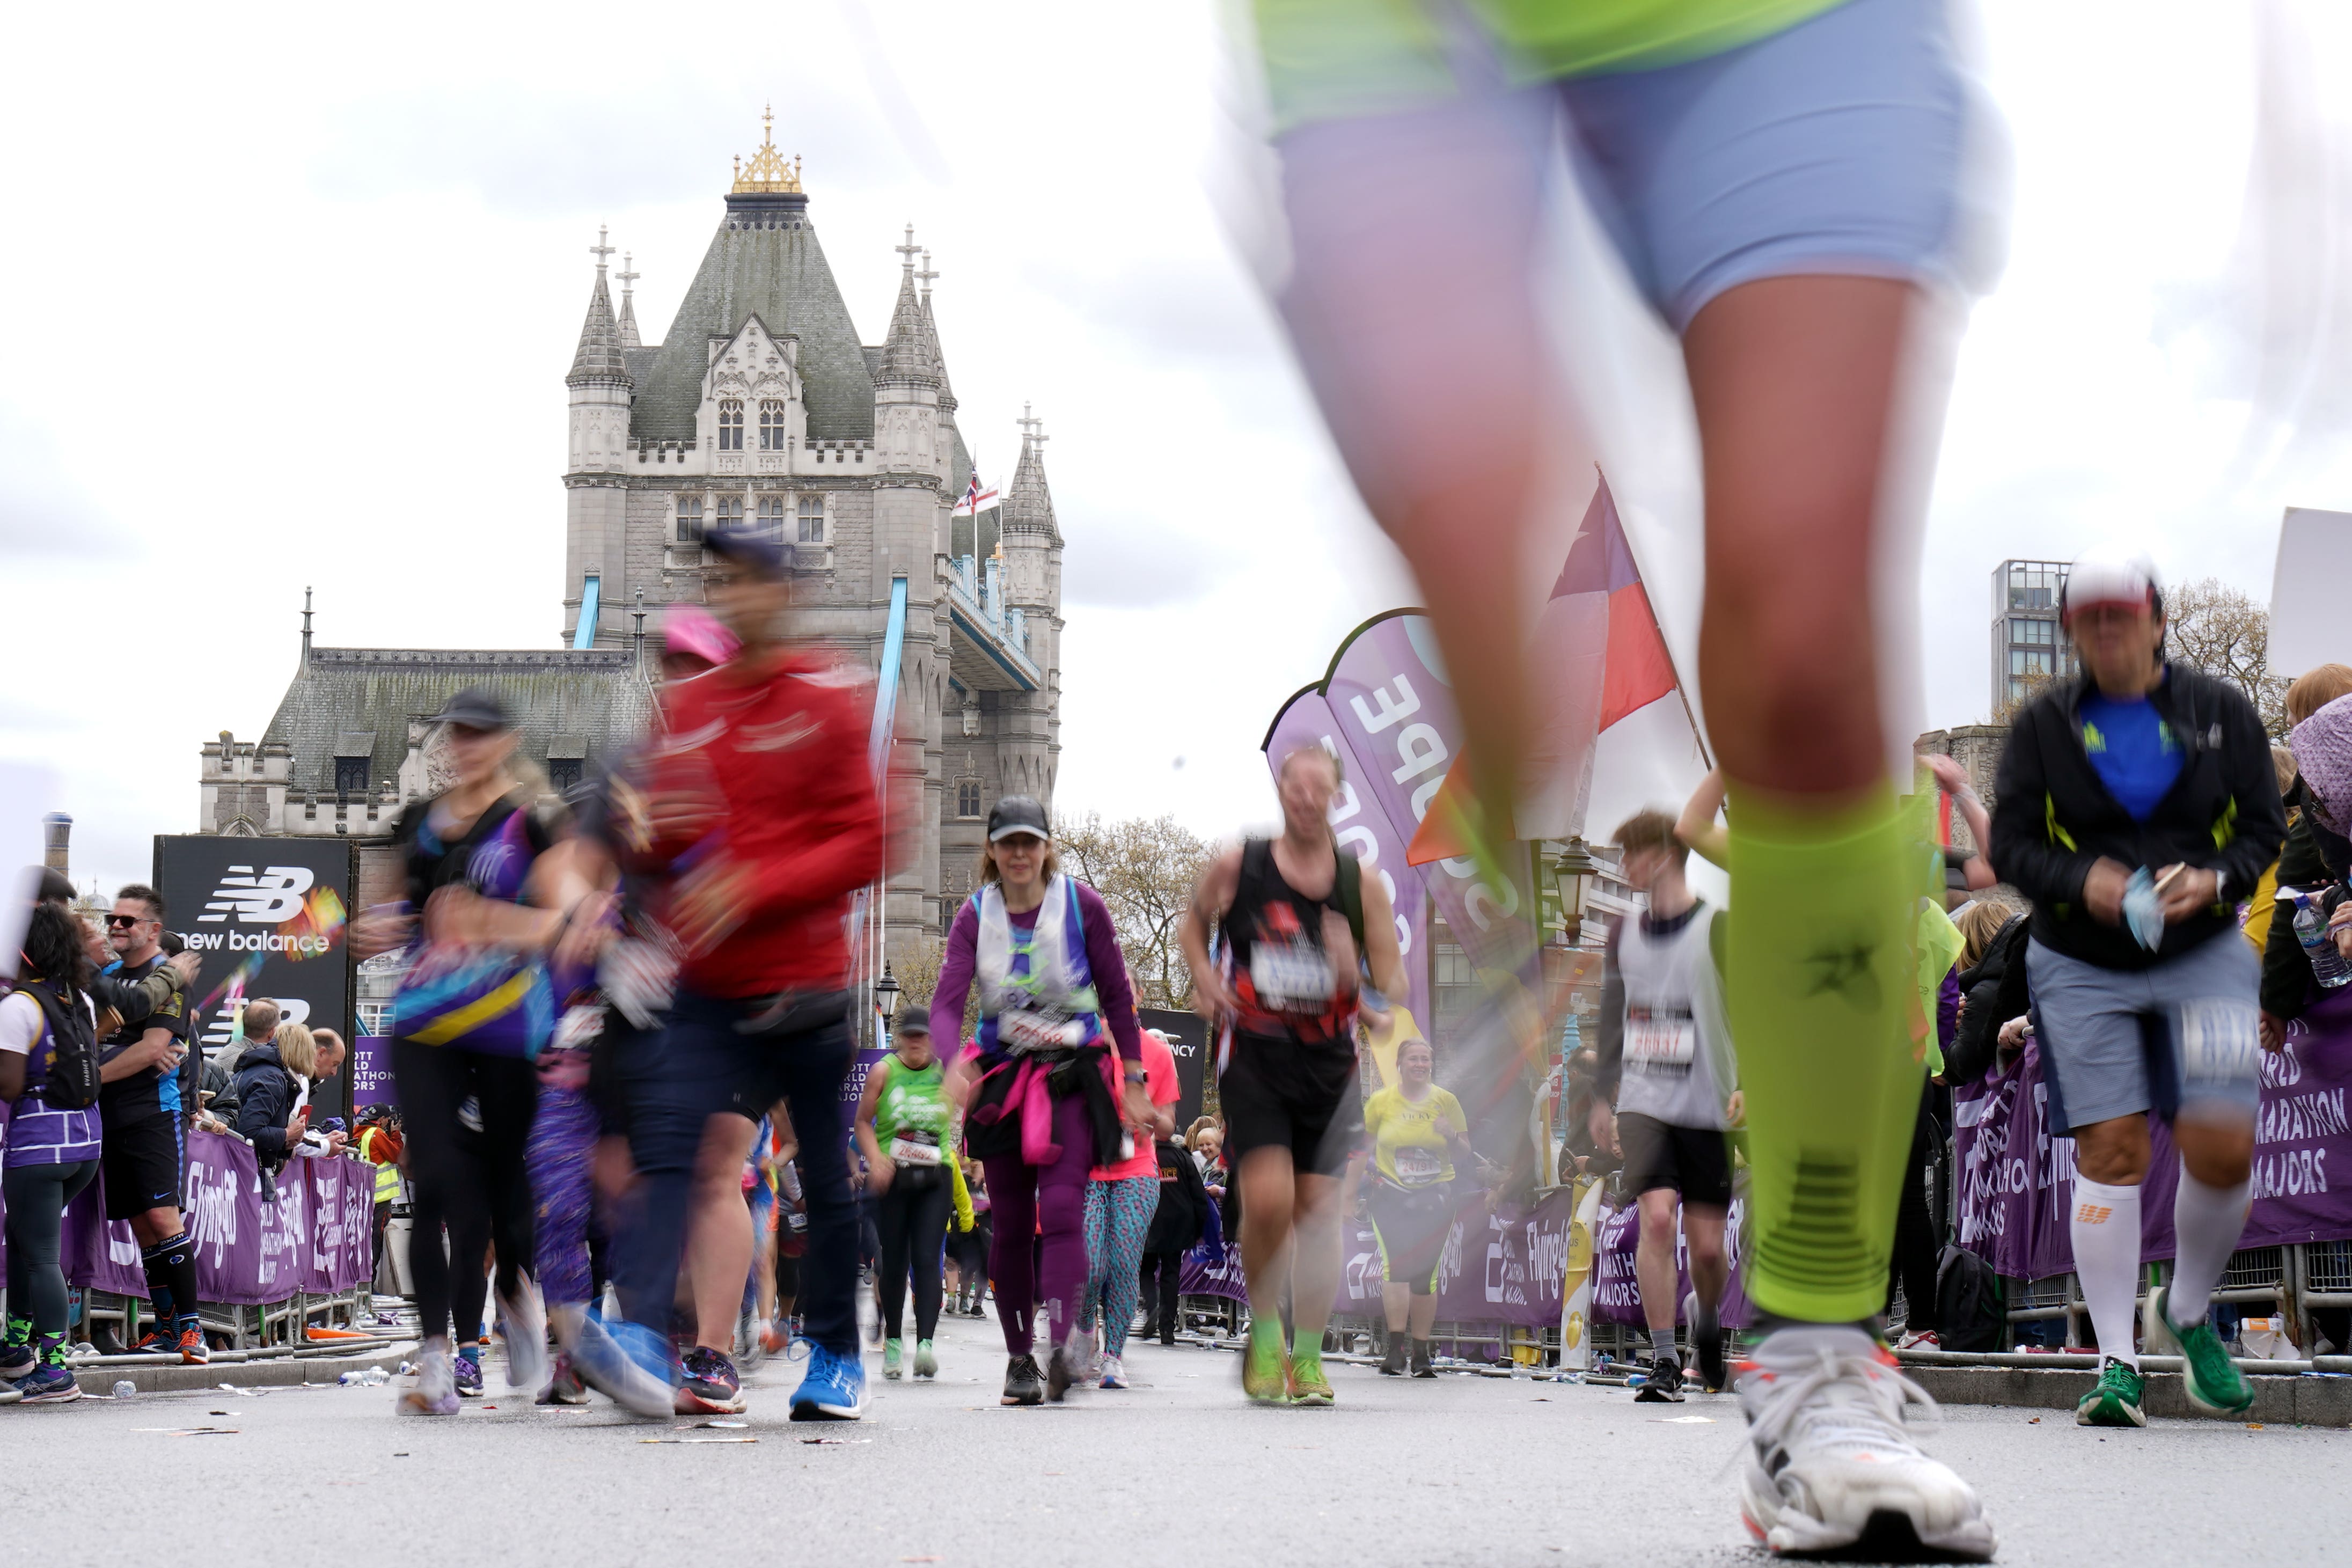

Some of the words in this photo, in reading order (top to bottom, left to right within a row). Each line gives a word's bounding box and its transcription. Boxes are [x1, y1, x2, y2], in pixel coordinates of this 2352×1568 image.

[197, 865, 314, 923] NB
[176, 933, 224, 950] new
[229, 929, 329, 952] balance
[2253, 1148, 2328, 1199] MAJORS
[1600, 1280, 1641, 1307] MAJORS
